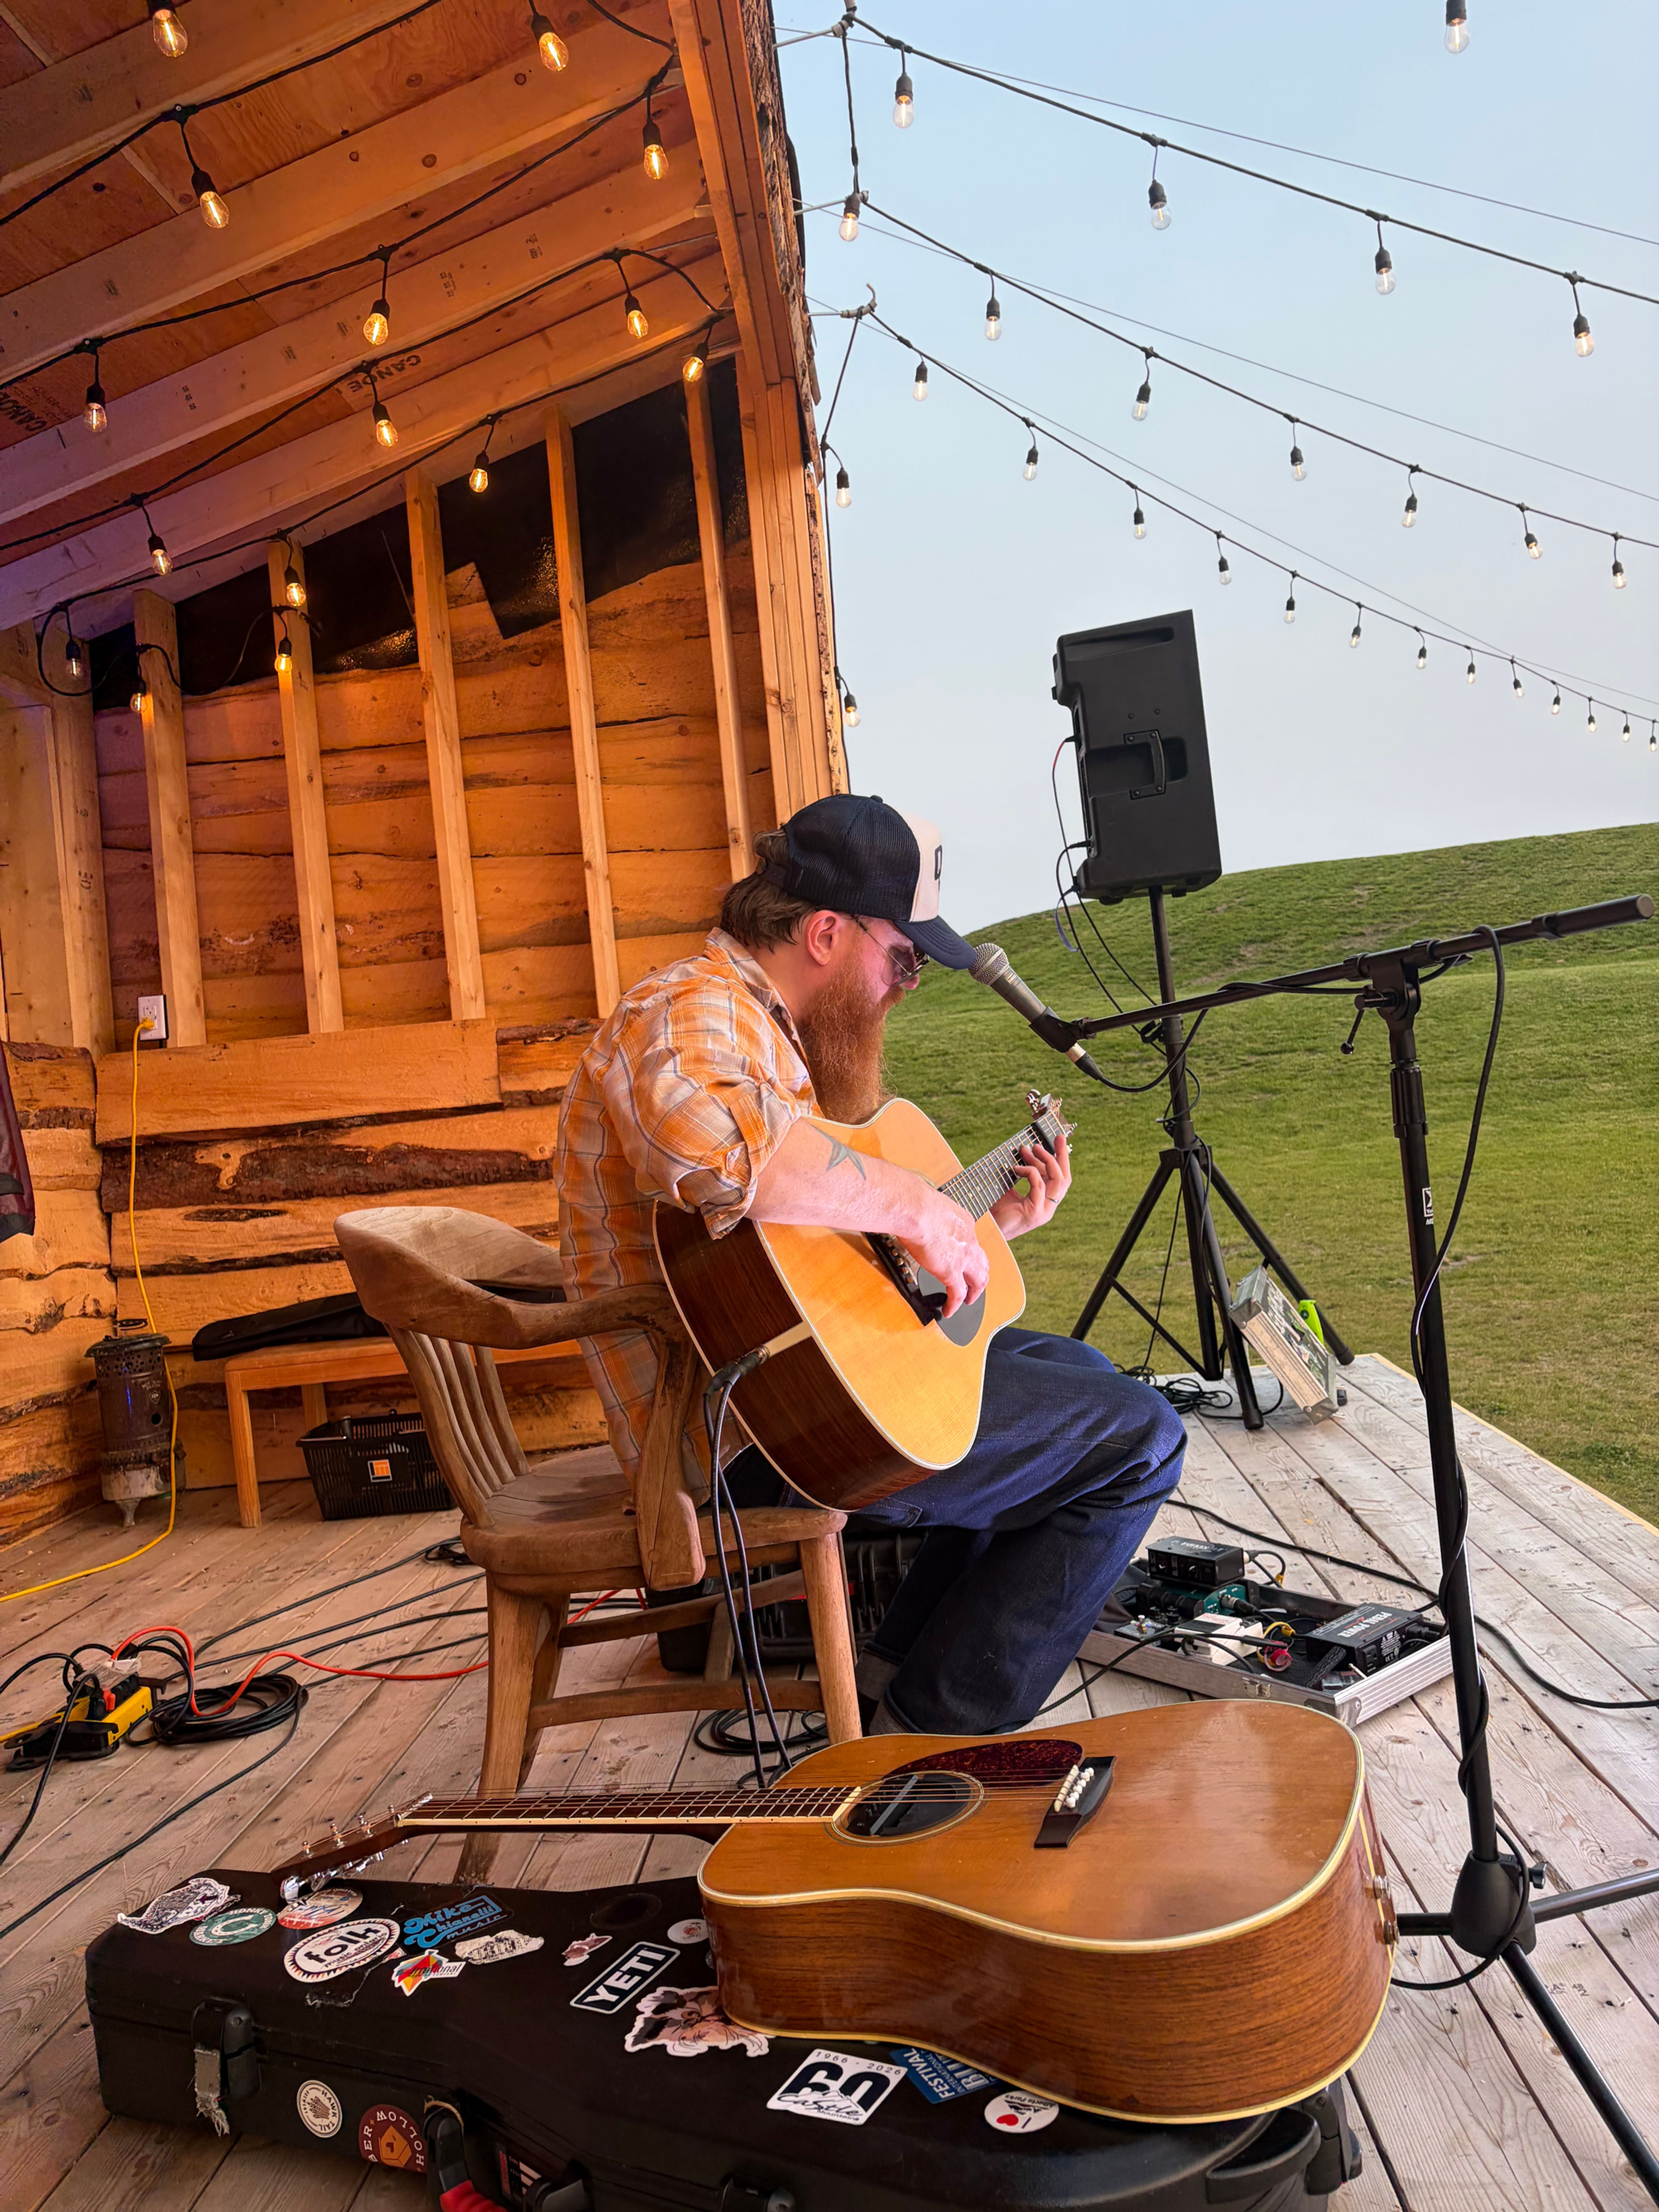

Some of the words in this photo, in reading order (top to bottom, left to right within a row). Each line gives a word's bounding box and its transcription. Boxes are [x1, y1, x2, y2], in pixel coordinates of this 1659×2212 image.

[347, 355, 421, 393] CANOE
[404, 1902, 485, 1934] Mike
[447, 1914, 507, 1939] music
[304, 1927, 381, 1963] folk
[324, 1953, 352, 1968] music
[354, 1932, 387, 1951] ontario
[582, 1949, 666, 2003] YETI
[816, 2051, 848, 2063] 1966
[866, 2063, 902, 2076] 2026
[903, 2048, 955, 2099] FESTIVAL
[926, 2053, 966, 2094] INTERNATIONAL
[321, 2090, 337, 2118] HAWK
[779, 2061, 891, 2113] 60
[1005, 2094, 1027, 2102] Parks
[1027, 2098, 1056, 2108] Alberta
[318, 2120, 335, 2131] TAIL
[376, 2111, 425, 2166] HOLLOW
